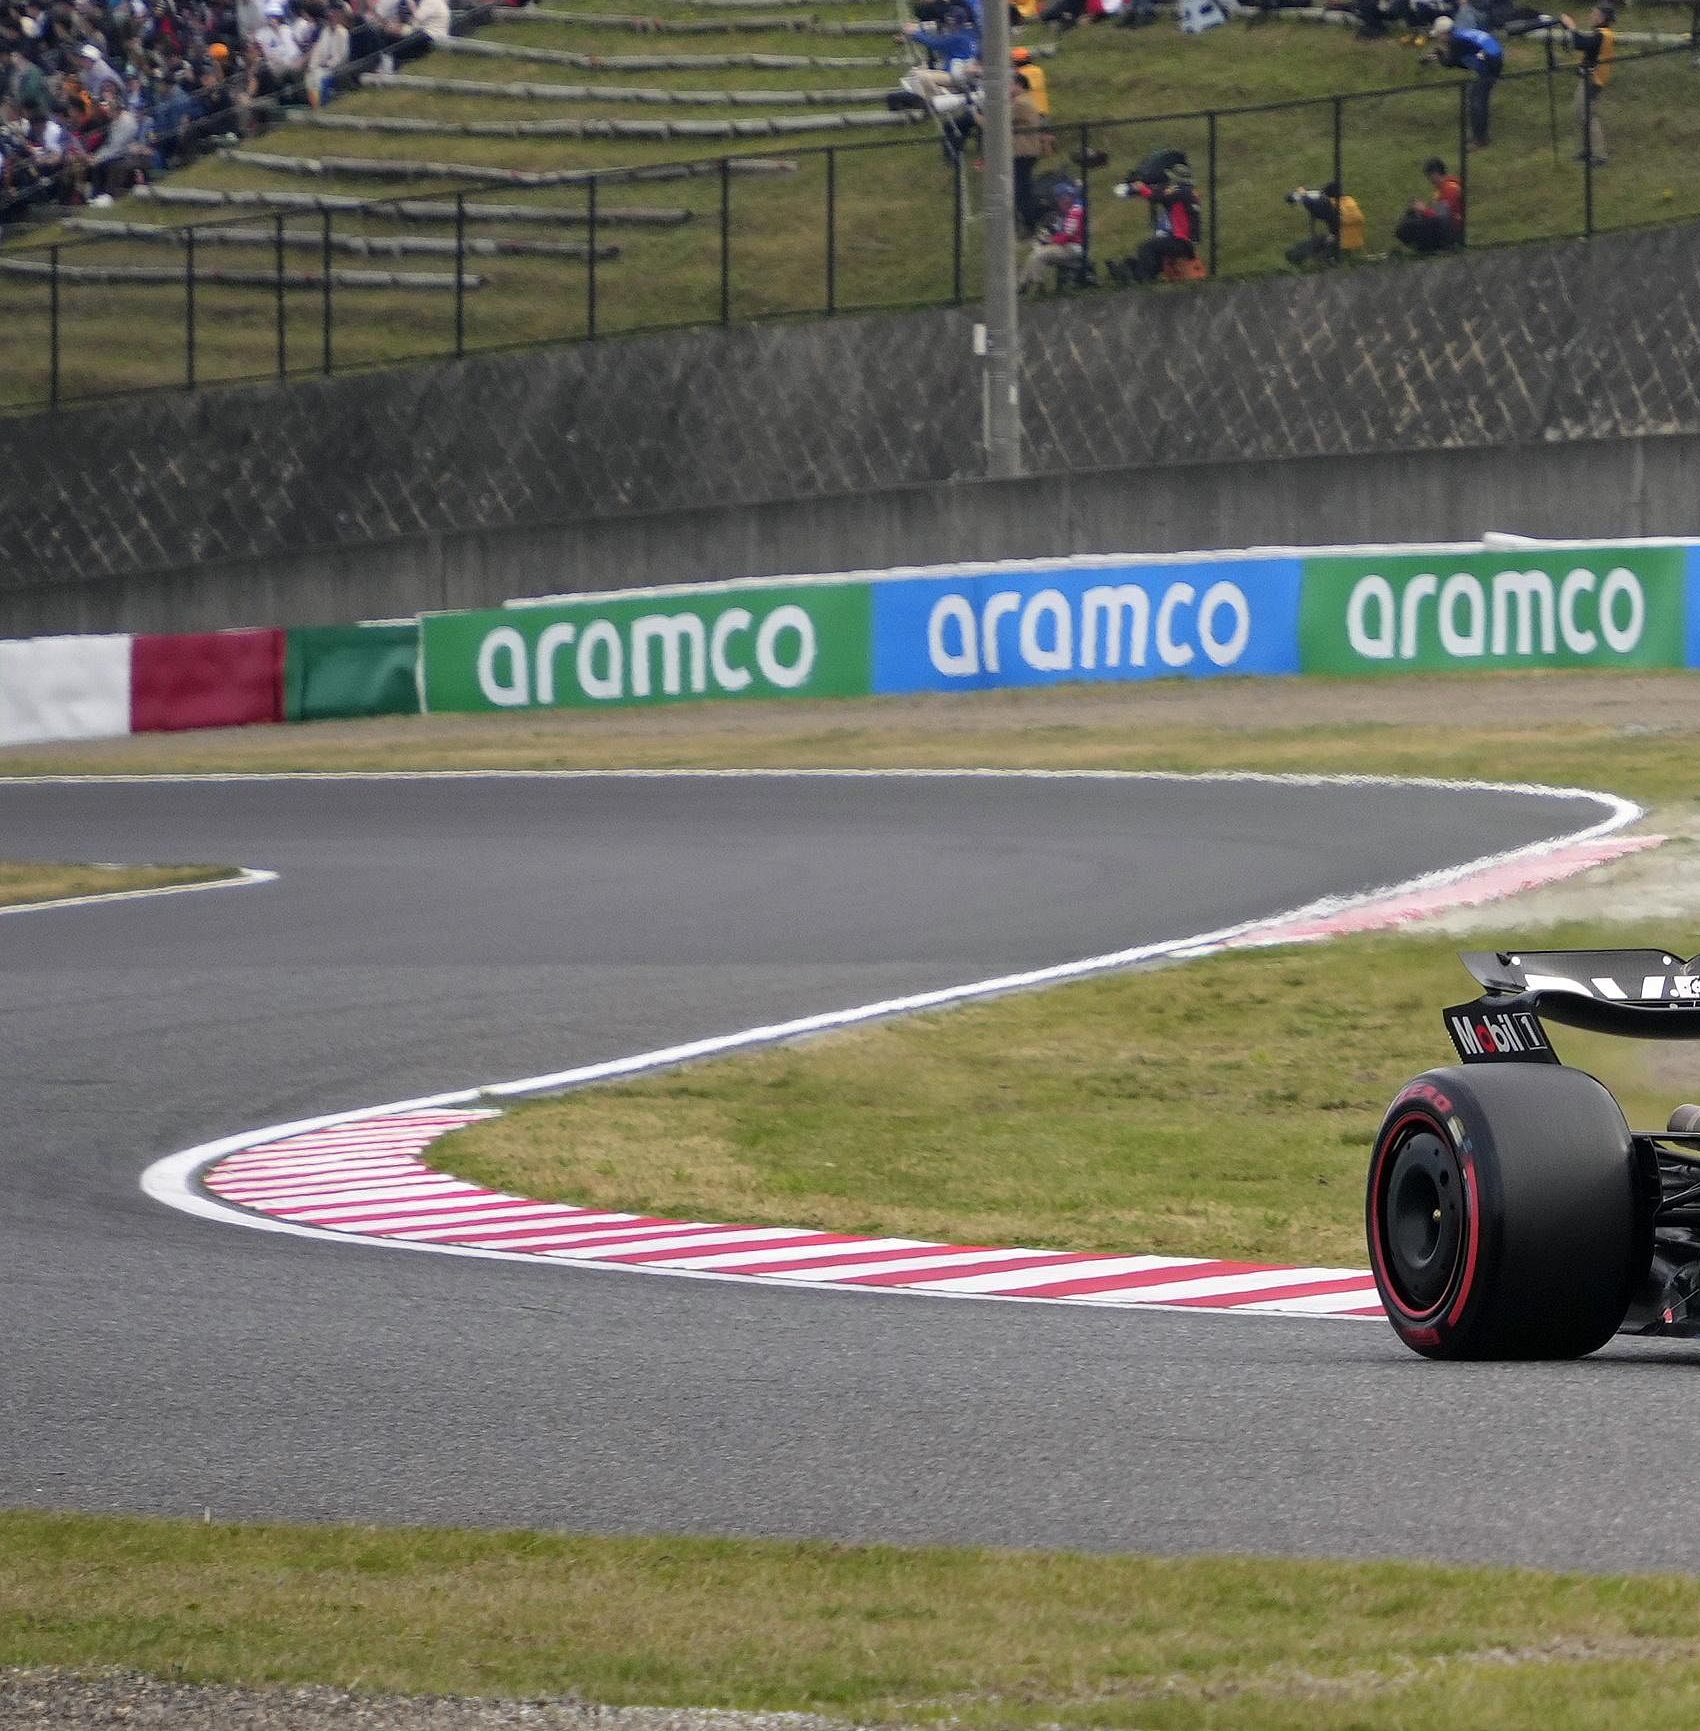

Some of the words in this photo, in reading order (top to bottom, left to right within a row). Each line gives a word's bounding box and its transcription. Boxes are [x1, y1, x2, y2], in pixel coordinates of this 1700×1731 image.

[478, 604, 816, 707] aramco
[927, 579, 1250, 677] aramco
[1347, 568, 1645, 660] aramco
[1451, 1013, 1525, 1055] Mobil
[1518, 1014, 1542, 1047] 1
